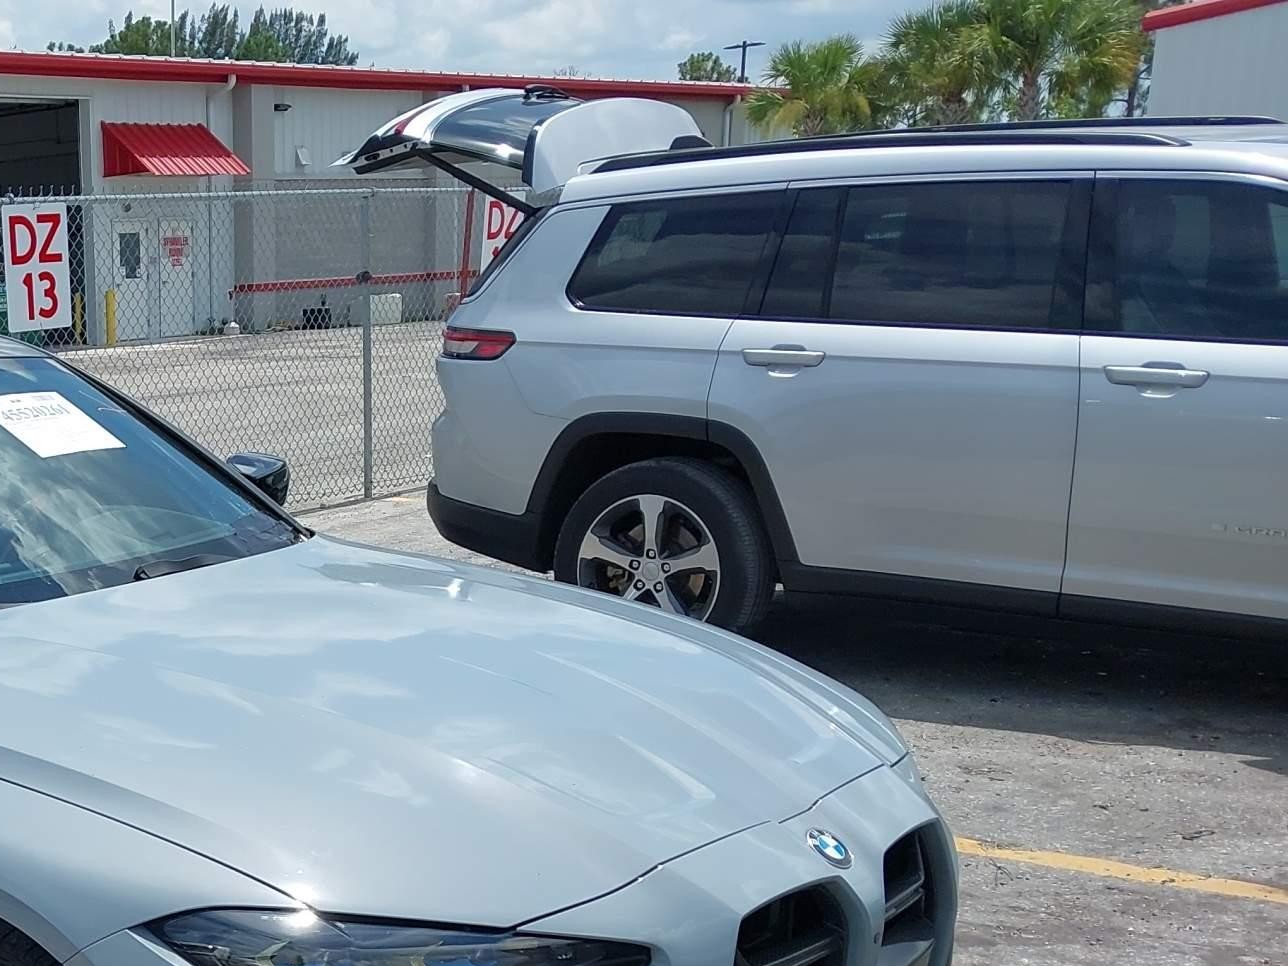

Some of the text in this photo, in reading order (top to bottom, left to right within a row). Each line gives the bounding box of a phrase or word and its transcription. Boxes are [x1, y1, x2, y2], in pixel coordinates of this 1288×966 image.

[8, 213, 63, 266] DZ
[22, 271, 59, 321] 13
[0, 402, 72, 422] 45520261
